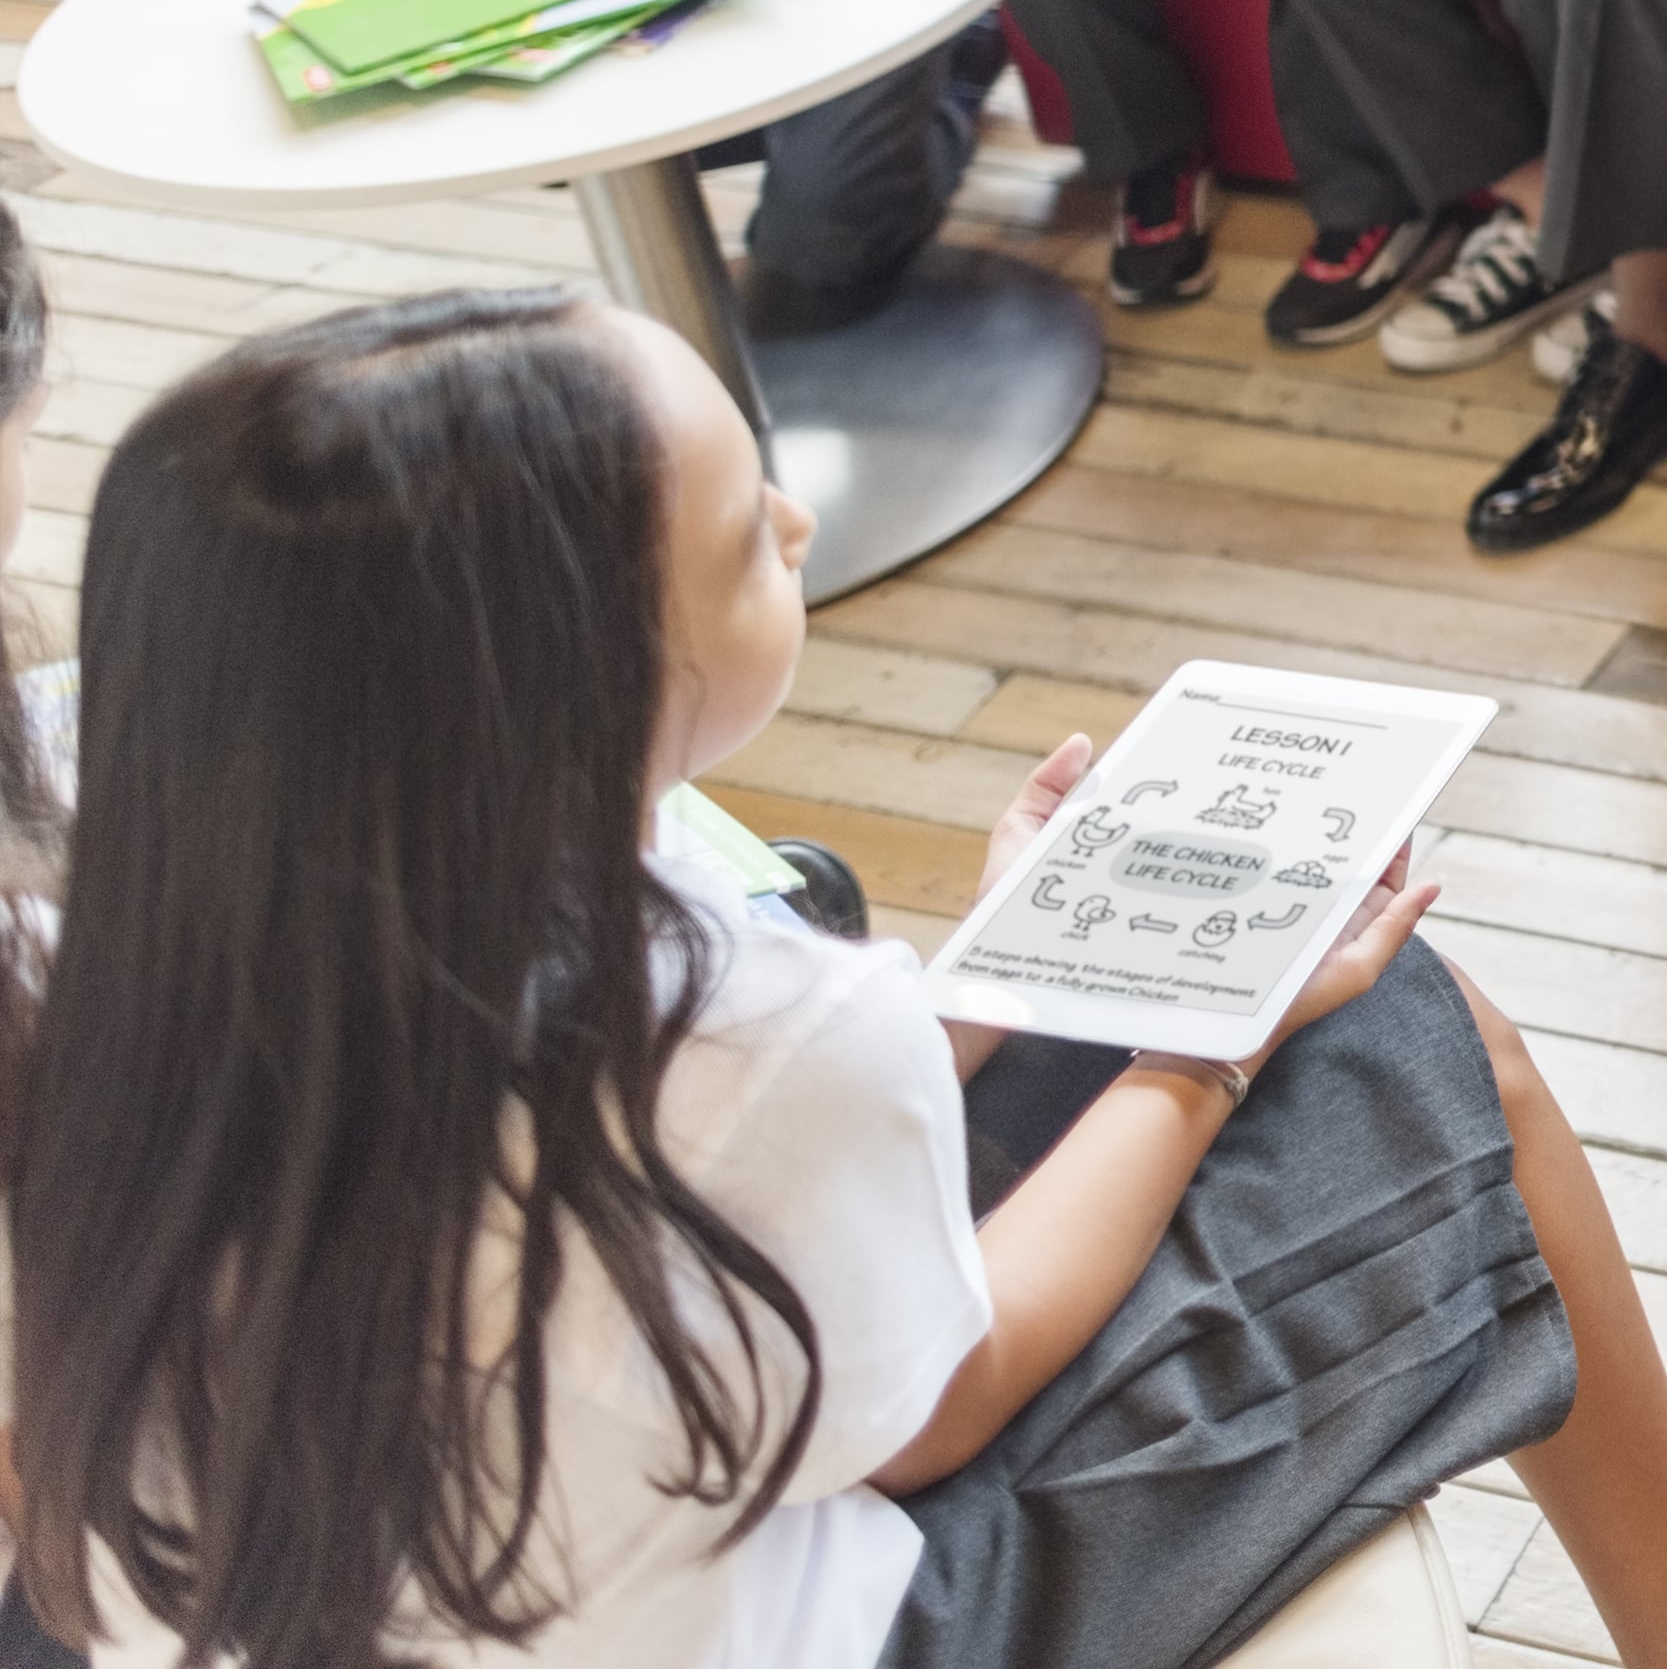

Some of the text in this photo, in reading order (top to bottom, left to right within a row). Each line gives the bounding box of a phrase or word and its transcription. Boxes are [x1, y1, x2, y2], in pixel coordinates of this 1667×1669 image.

[1179, 688, 1222, 704] Name
[1230, 724, 1340, 755] LESSON
[1217, 753, 1327, 780] LIFE CYCLE
[1132, 839, 1267, 872] THE CHICKEN
[1124, 861, 1240, 891] LIFE CYCLE
[957, 959, 989, 975] from
[990, 967, 1022, 981] eggs
[1055, 974, 1084, 991] fully
[1084, 980, 1128, 997] grown
[1128, 985, 1180, 1003] Chicken
[982, 947, 1022, 965] steps
[1023, 953, 1077, 974] showing
[1082, 963, 1105, 977] the
[1106, 966, 1153, 985] stages
[1170, 975, 1257, 999] development
